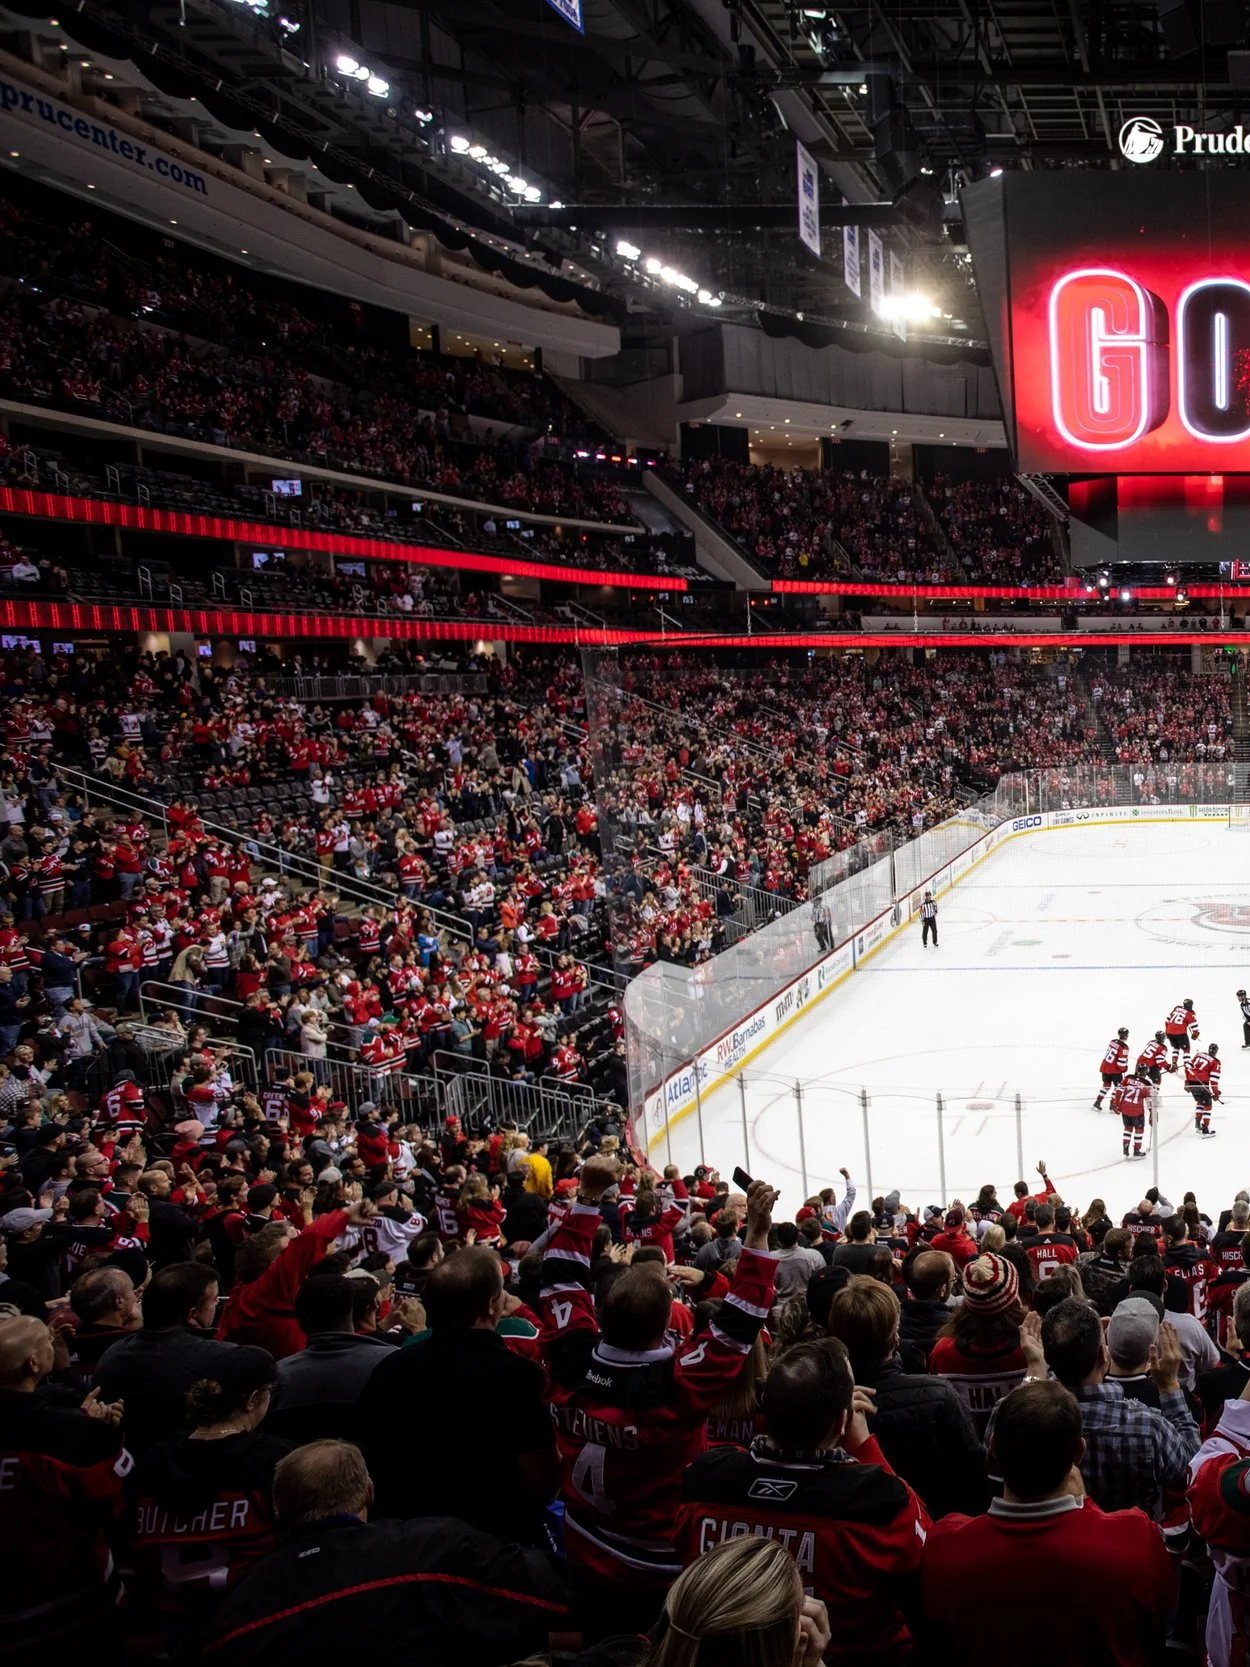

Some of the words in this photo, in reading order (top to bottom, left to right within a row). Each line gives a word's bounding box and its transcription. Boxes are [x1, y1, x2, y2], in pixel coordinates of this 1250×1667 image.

[0, 81, 209, 195] prucenter.com
[1012, 815, 1042, 832] GEICO
[1091, 810, 1128, 818] INFINITI
[1168, 1011, 1187, 1025] 76
[724, 1045, 746, 1071] HEALTH
[667, 1063, 708, 1106] Atlanic
[1125, 1086, 1141, 1105] 21
[107, 1095, 121, 1118] 6
[265, 1100, 282, 1122] 6
[1127, 1224, 1156, 1234] HISCHIER
[1036, 1248, 1058, 1259] HALL
[1221, 1250, 1241, 1261] HISC
[1174, 1263, 1205, 1279] ELIAS
[551, 1298, 573, 1330] 4
[549, 1401, 639, 1452] STEVENS
[705, 1417, 754, 1441] EMAN
[571, 1441, 617, 1516] 4
